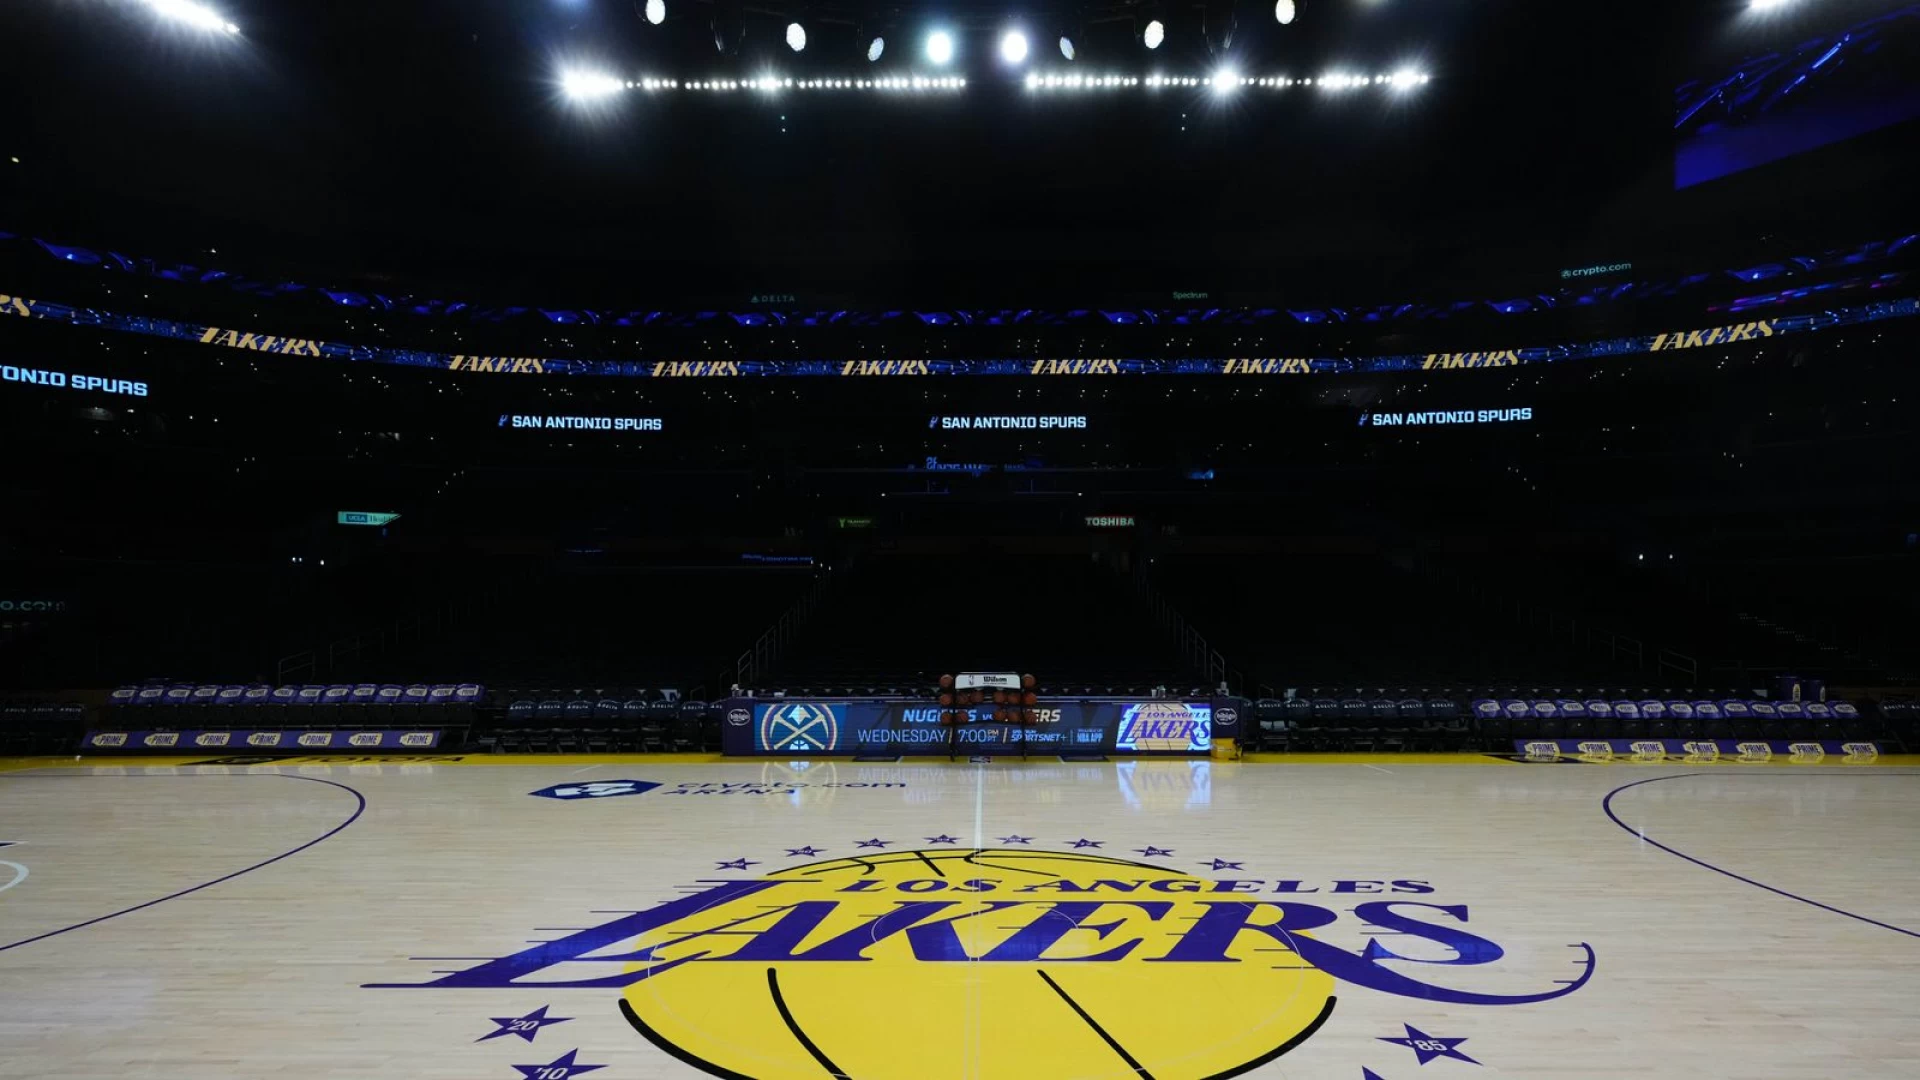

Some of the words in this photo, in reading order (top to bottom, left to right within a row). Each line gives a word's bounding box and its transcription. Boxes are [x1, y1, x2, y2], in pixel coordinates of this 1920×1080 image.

[1572, 262, 1631, 277] crypto.com
[762, 294, 796, 303] DELTA
[1172, 291, 1208, 300] Spectrum
[0, 364, 66, 387] ONIO
[71, 374, 148, 397] SPURS
[1372, 413, 1402, 426] SAN
[1405, 411, 1475, 425] ANTONIO
[1477, 407, 1532, 422] SPURS
[512, 415, 542, 428] SAN
[545, 416, 612, 429] ANTONIO
[614, 418, 662, 430] SPURS
[942, 416, 971, 429] SAN
[973, 416, 1037, 429] ANTONIO
[1039, 416, 1087, 428] SPURS
[1084, 516, 1135, 526] TOSHIBA
[902, 708, 978, 722] NUGS
[1146, 711, 1165, 719] LOS
[1119, 712, 1210, 747] LAKERS
[100, 735, 122, 745] PRIME
[153, 735, 174, 745] PRIME
[203, 735, 225, 745] PRIME
[255, 735, 277, 745] PRIME
[305, 735, 327, 745] PRIME
[356, 735, 378, 745] PRIME
[407, 735, 429, 745] PRIME
[857, 729, 946, 743] WEDNESDAY
[958, 729, 987, 743] 7:00
[1532, 743, 1556, 753] PRIME
[1585, 743, 1608, 753] PRIME
[1637, 743, 1661, 753] PRIME
[1690, 743, 1714, 754] PRIME
[1744, 744, 1766, 755] PRIME
[1796, 744, 1819, 755] PRIME
[1849, 745, 1872, 756] PRIME
[835, 879, 1001, 893] LOS
[1021, 879, 1437, 894] ANGELES
[360, 879, 1597, 1006] LAKERS
[506, 1018, 540, 1031] '20
[533, 1067, 569, 1080] '10
